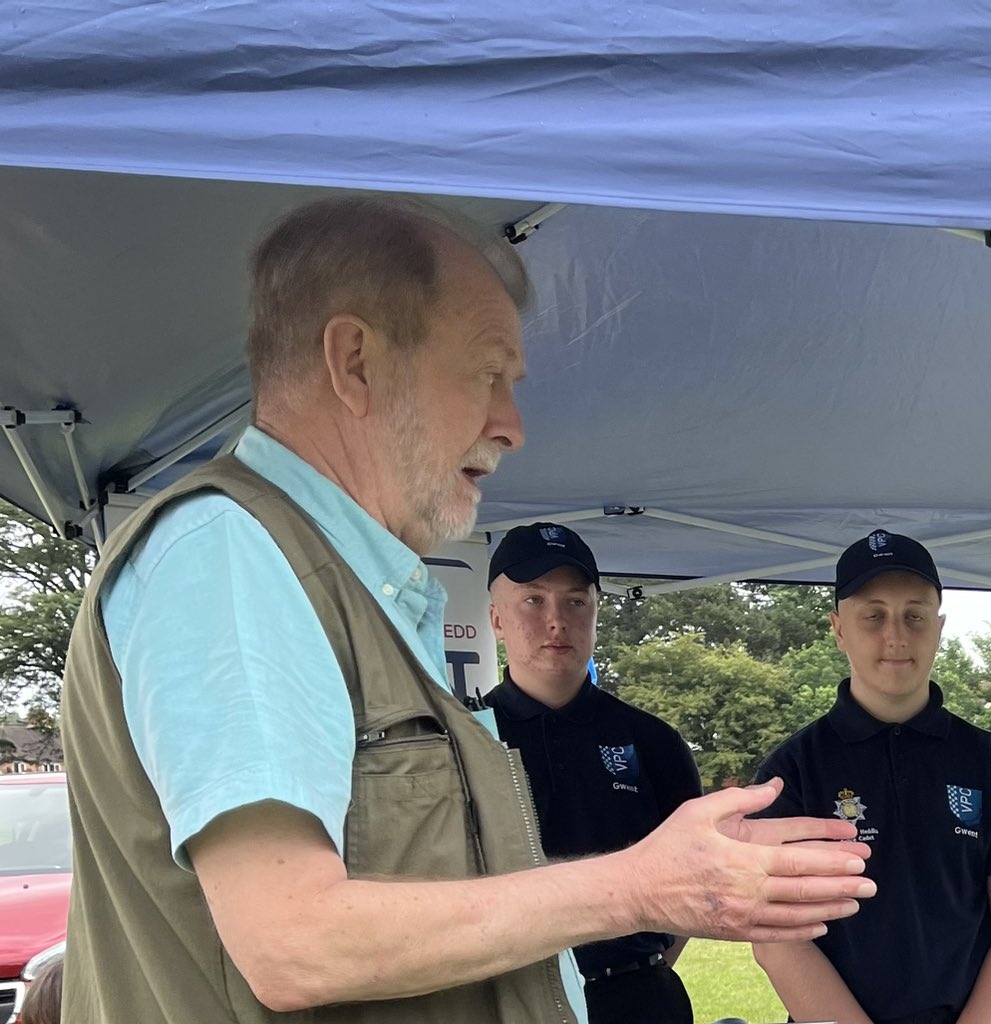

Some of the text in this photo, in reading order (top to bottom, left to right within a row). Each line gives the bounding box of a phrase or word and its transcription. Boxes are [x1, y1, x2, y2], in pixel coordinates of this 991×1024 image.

[611, 746, 628, 771] VPC
[612, 781, 639, 792] Gwent
[959, 787, 973, 812] VPC
[954, 826, 978, 839] Gwent
